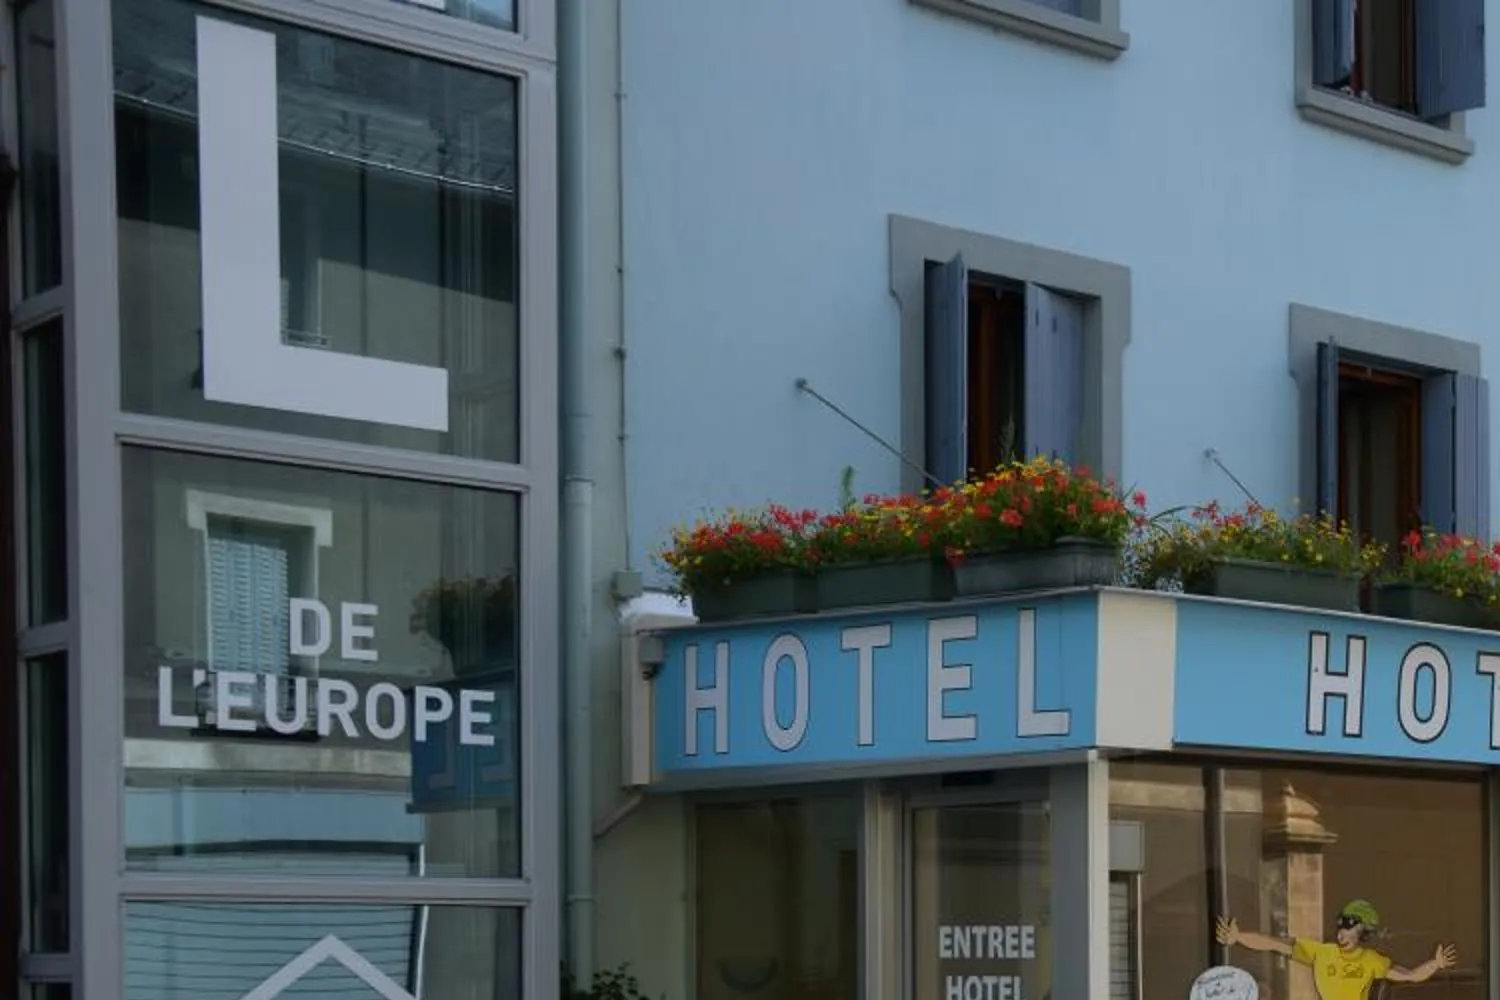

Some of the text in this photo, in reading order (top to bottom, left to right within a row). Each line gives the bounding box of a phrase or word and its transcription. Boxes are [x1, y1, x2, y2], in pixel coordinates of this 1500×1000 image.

[289, 597, 379, 661] DE
[158, 666, 496, 746] L'EUROPE
[684, 607, 1071, 757] HOTEL
[938, 925, 1036, 959] ENTREE
